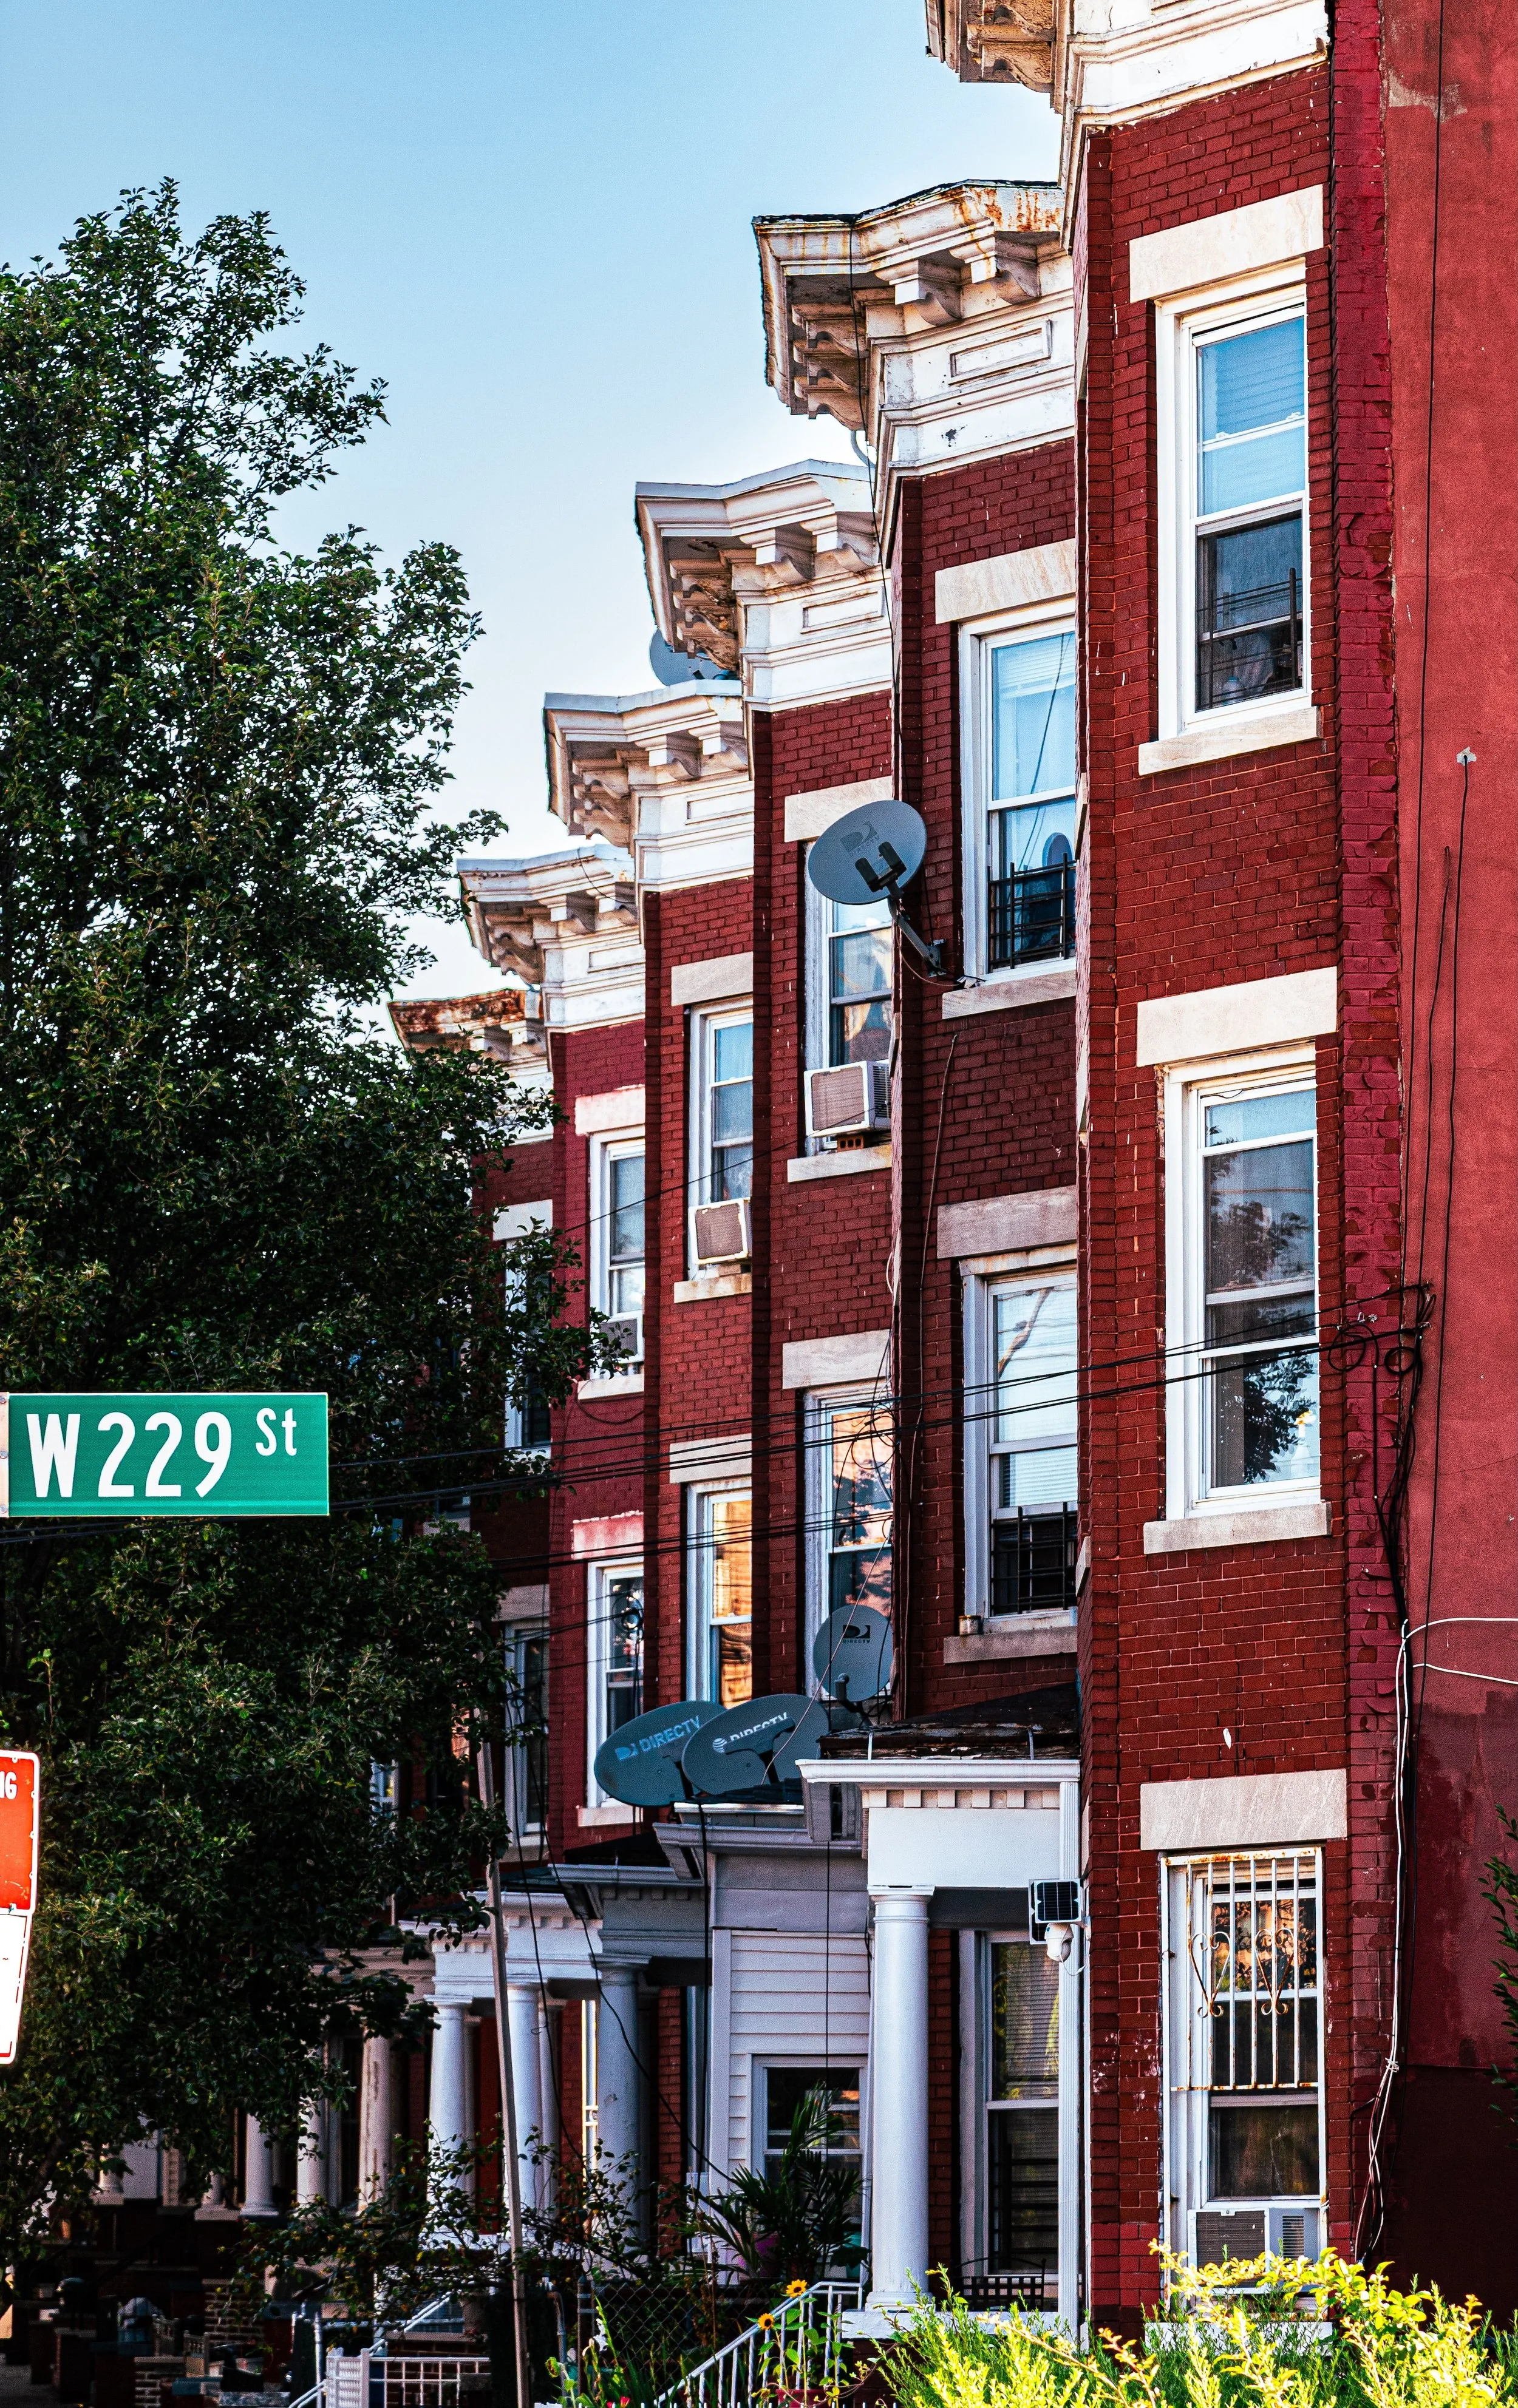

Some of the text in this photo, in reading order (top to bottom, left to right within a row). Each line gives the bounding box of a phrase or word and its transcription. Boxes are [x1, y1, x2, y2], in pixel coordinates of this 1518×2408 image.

[26, 1408, 298, 1498] W 229 St
[638, 1715, 701, 1753] DIRECTV
